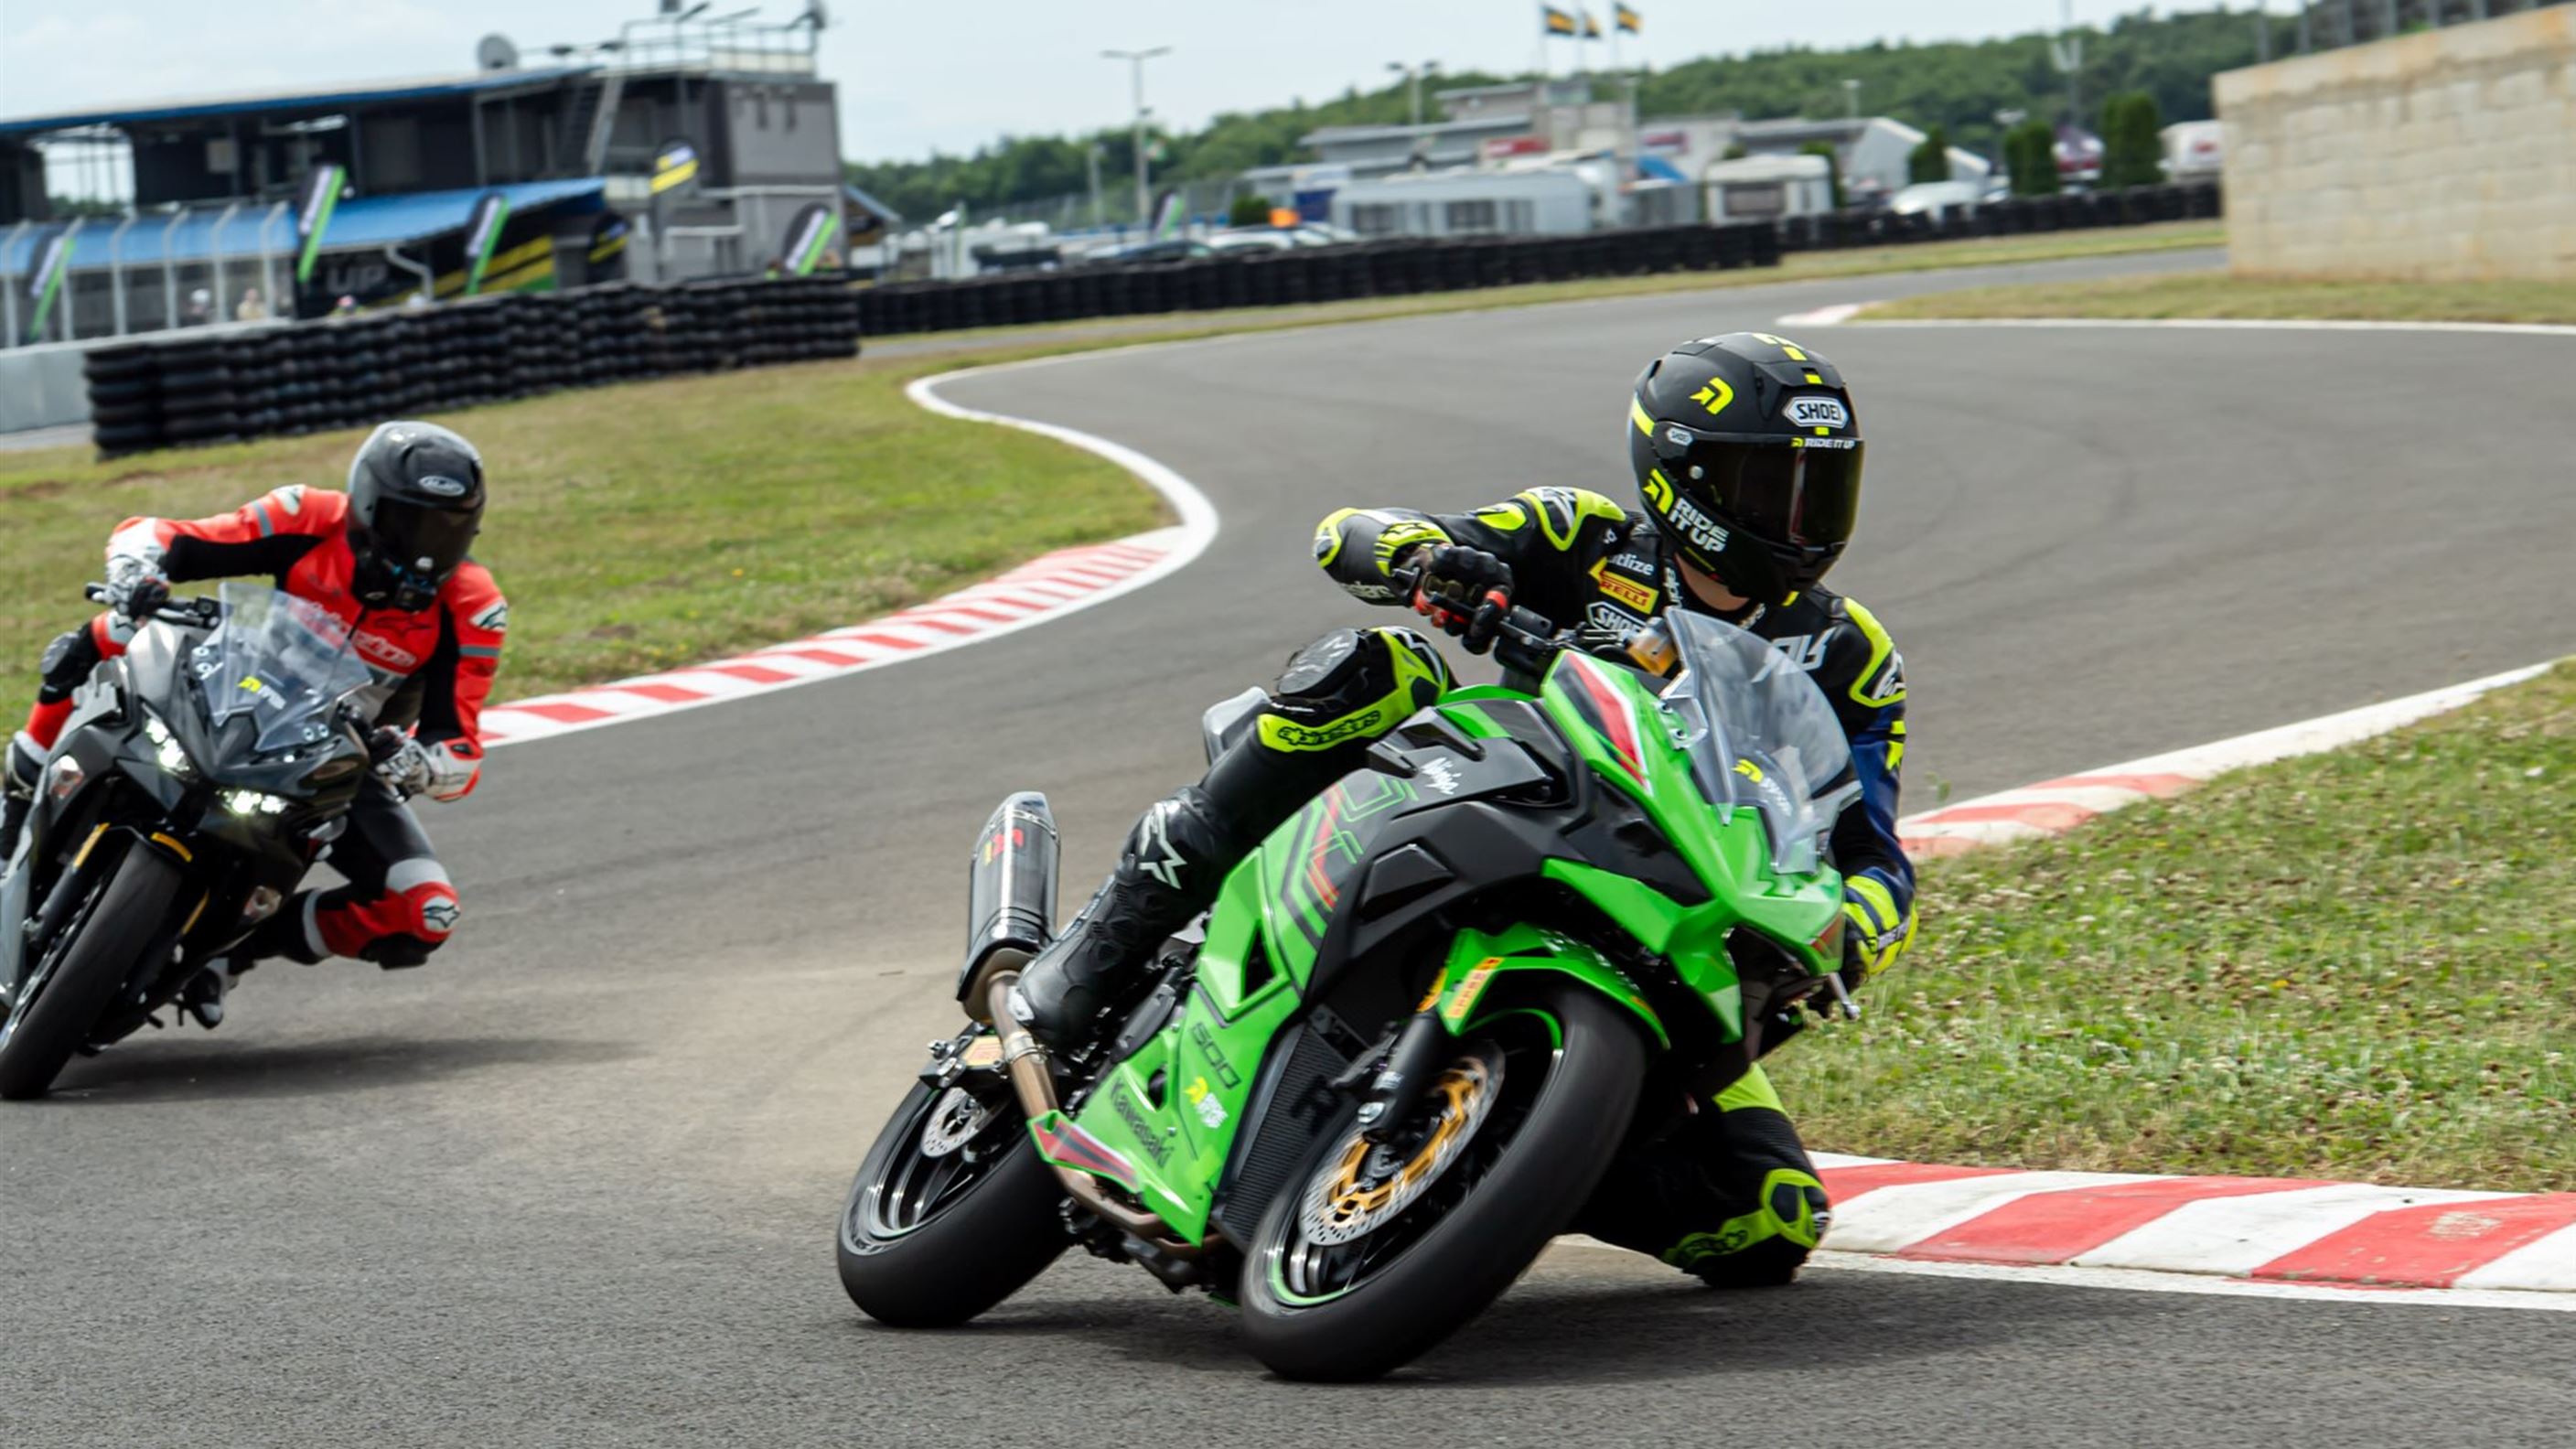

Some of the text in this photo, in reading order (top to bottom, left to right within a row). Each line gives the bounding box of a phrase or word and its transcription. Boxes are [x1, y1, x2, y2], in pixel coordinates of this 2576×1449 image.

[1797, 402, 1842, 421] SHOEI
[1805, 438, 1833, 448] RIDE
[1669, 509, 1726, 553] IT UP
[1675, 497, 1729, 542] RIDE
